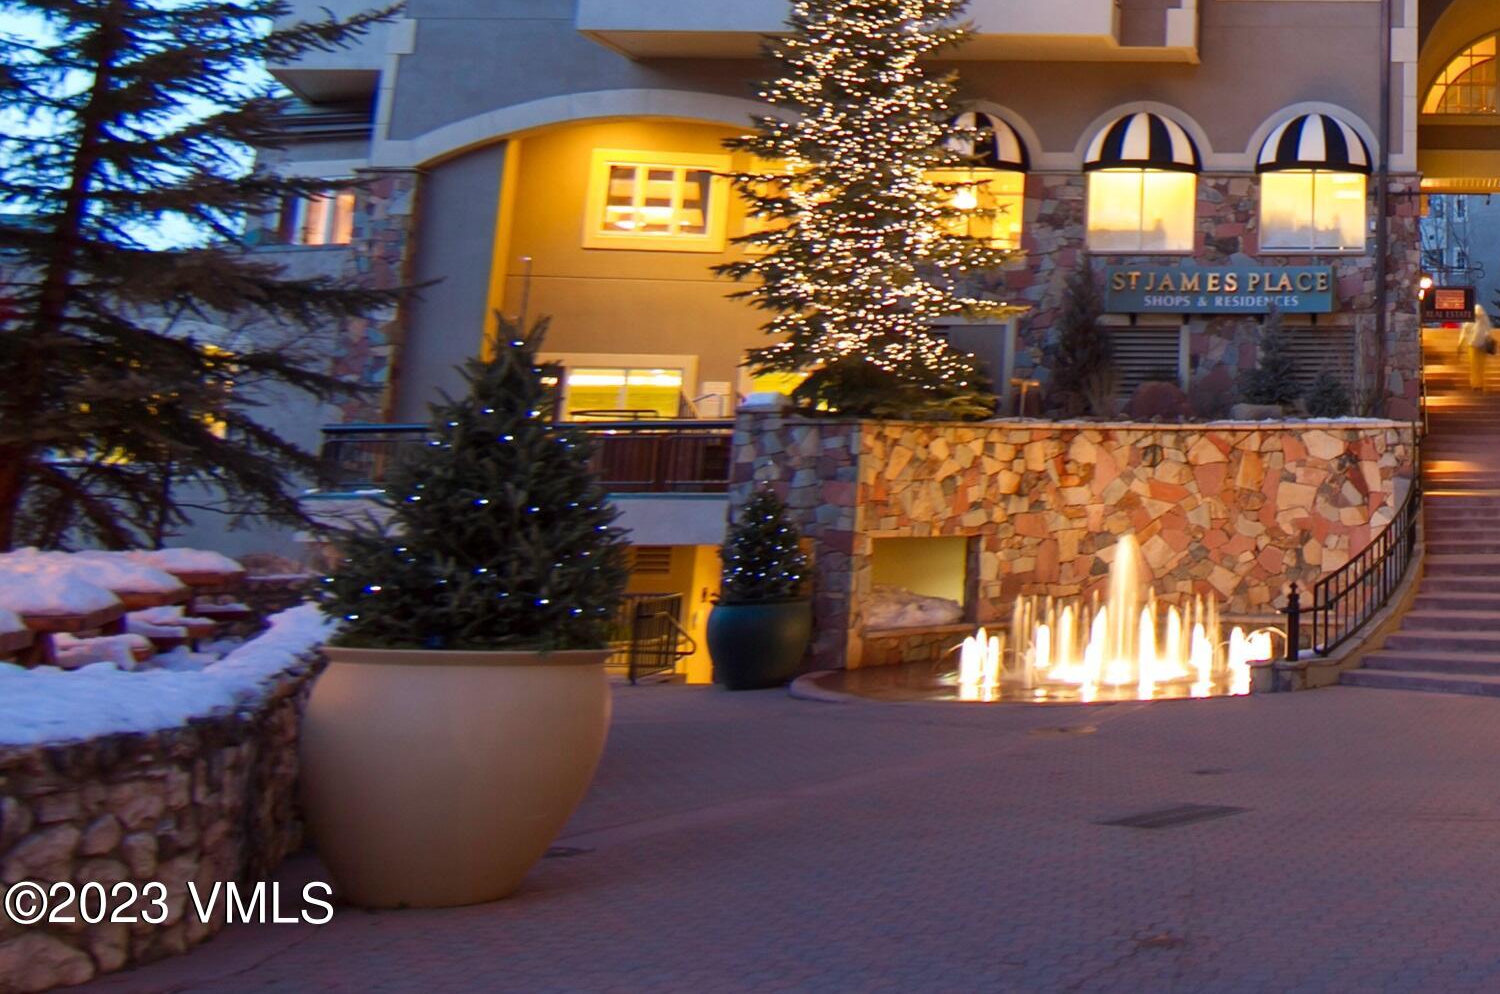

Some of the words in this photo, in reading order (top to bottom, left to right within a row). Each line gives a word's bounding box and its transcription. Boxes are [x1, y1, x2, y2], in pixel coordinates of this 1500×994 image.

[1144, 272, 1238, 292] JAMES
[1247, 272, 1329, 292] PLACE
[1144, 295, 1190, 307] SHOPS
[1197, 296, 1208, 307] &
[1445, 311, 1472, 319] ESTATE
